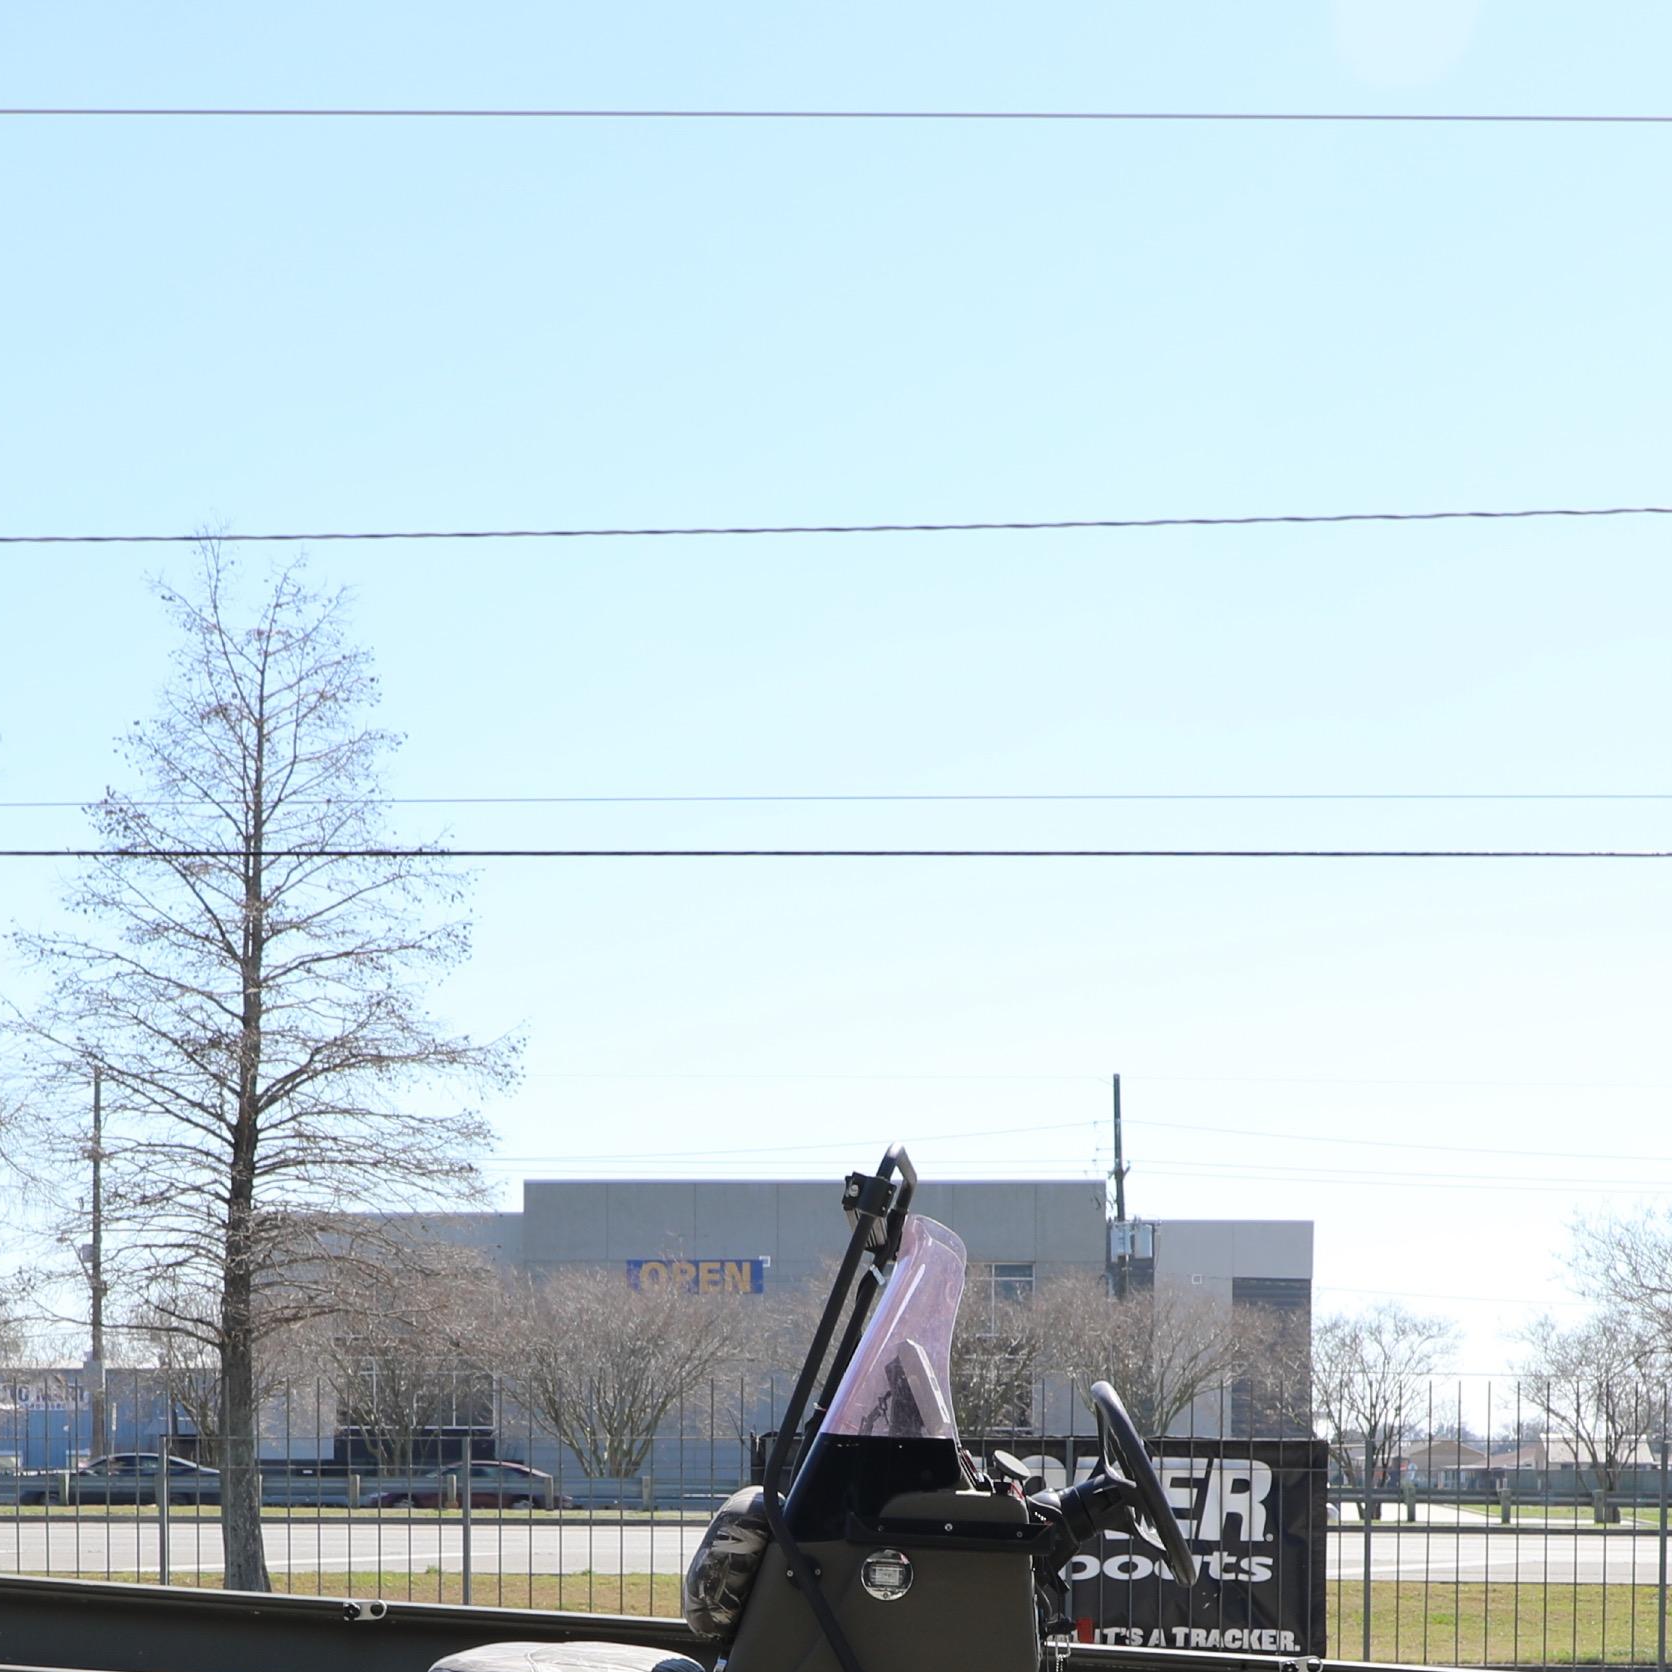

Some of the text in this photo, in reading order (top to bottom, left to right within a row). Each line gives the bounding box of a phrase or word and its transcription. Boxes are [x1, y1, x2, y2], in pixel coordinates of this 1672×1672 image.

[639, 1261, 752, 1294] OPEN
[1094, 1626, 1144, 1646] IT'S
[1149, 1628, 1167, 1648] A
[1171, 1627, 1301, 1651] TRACKER.
